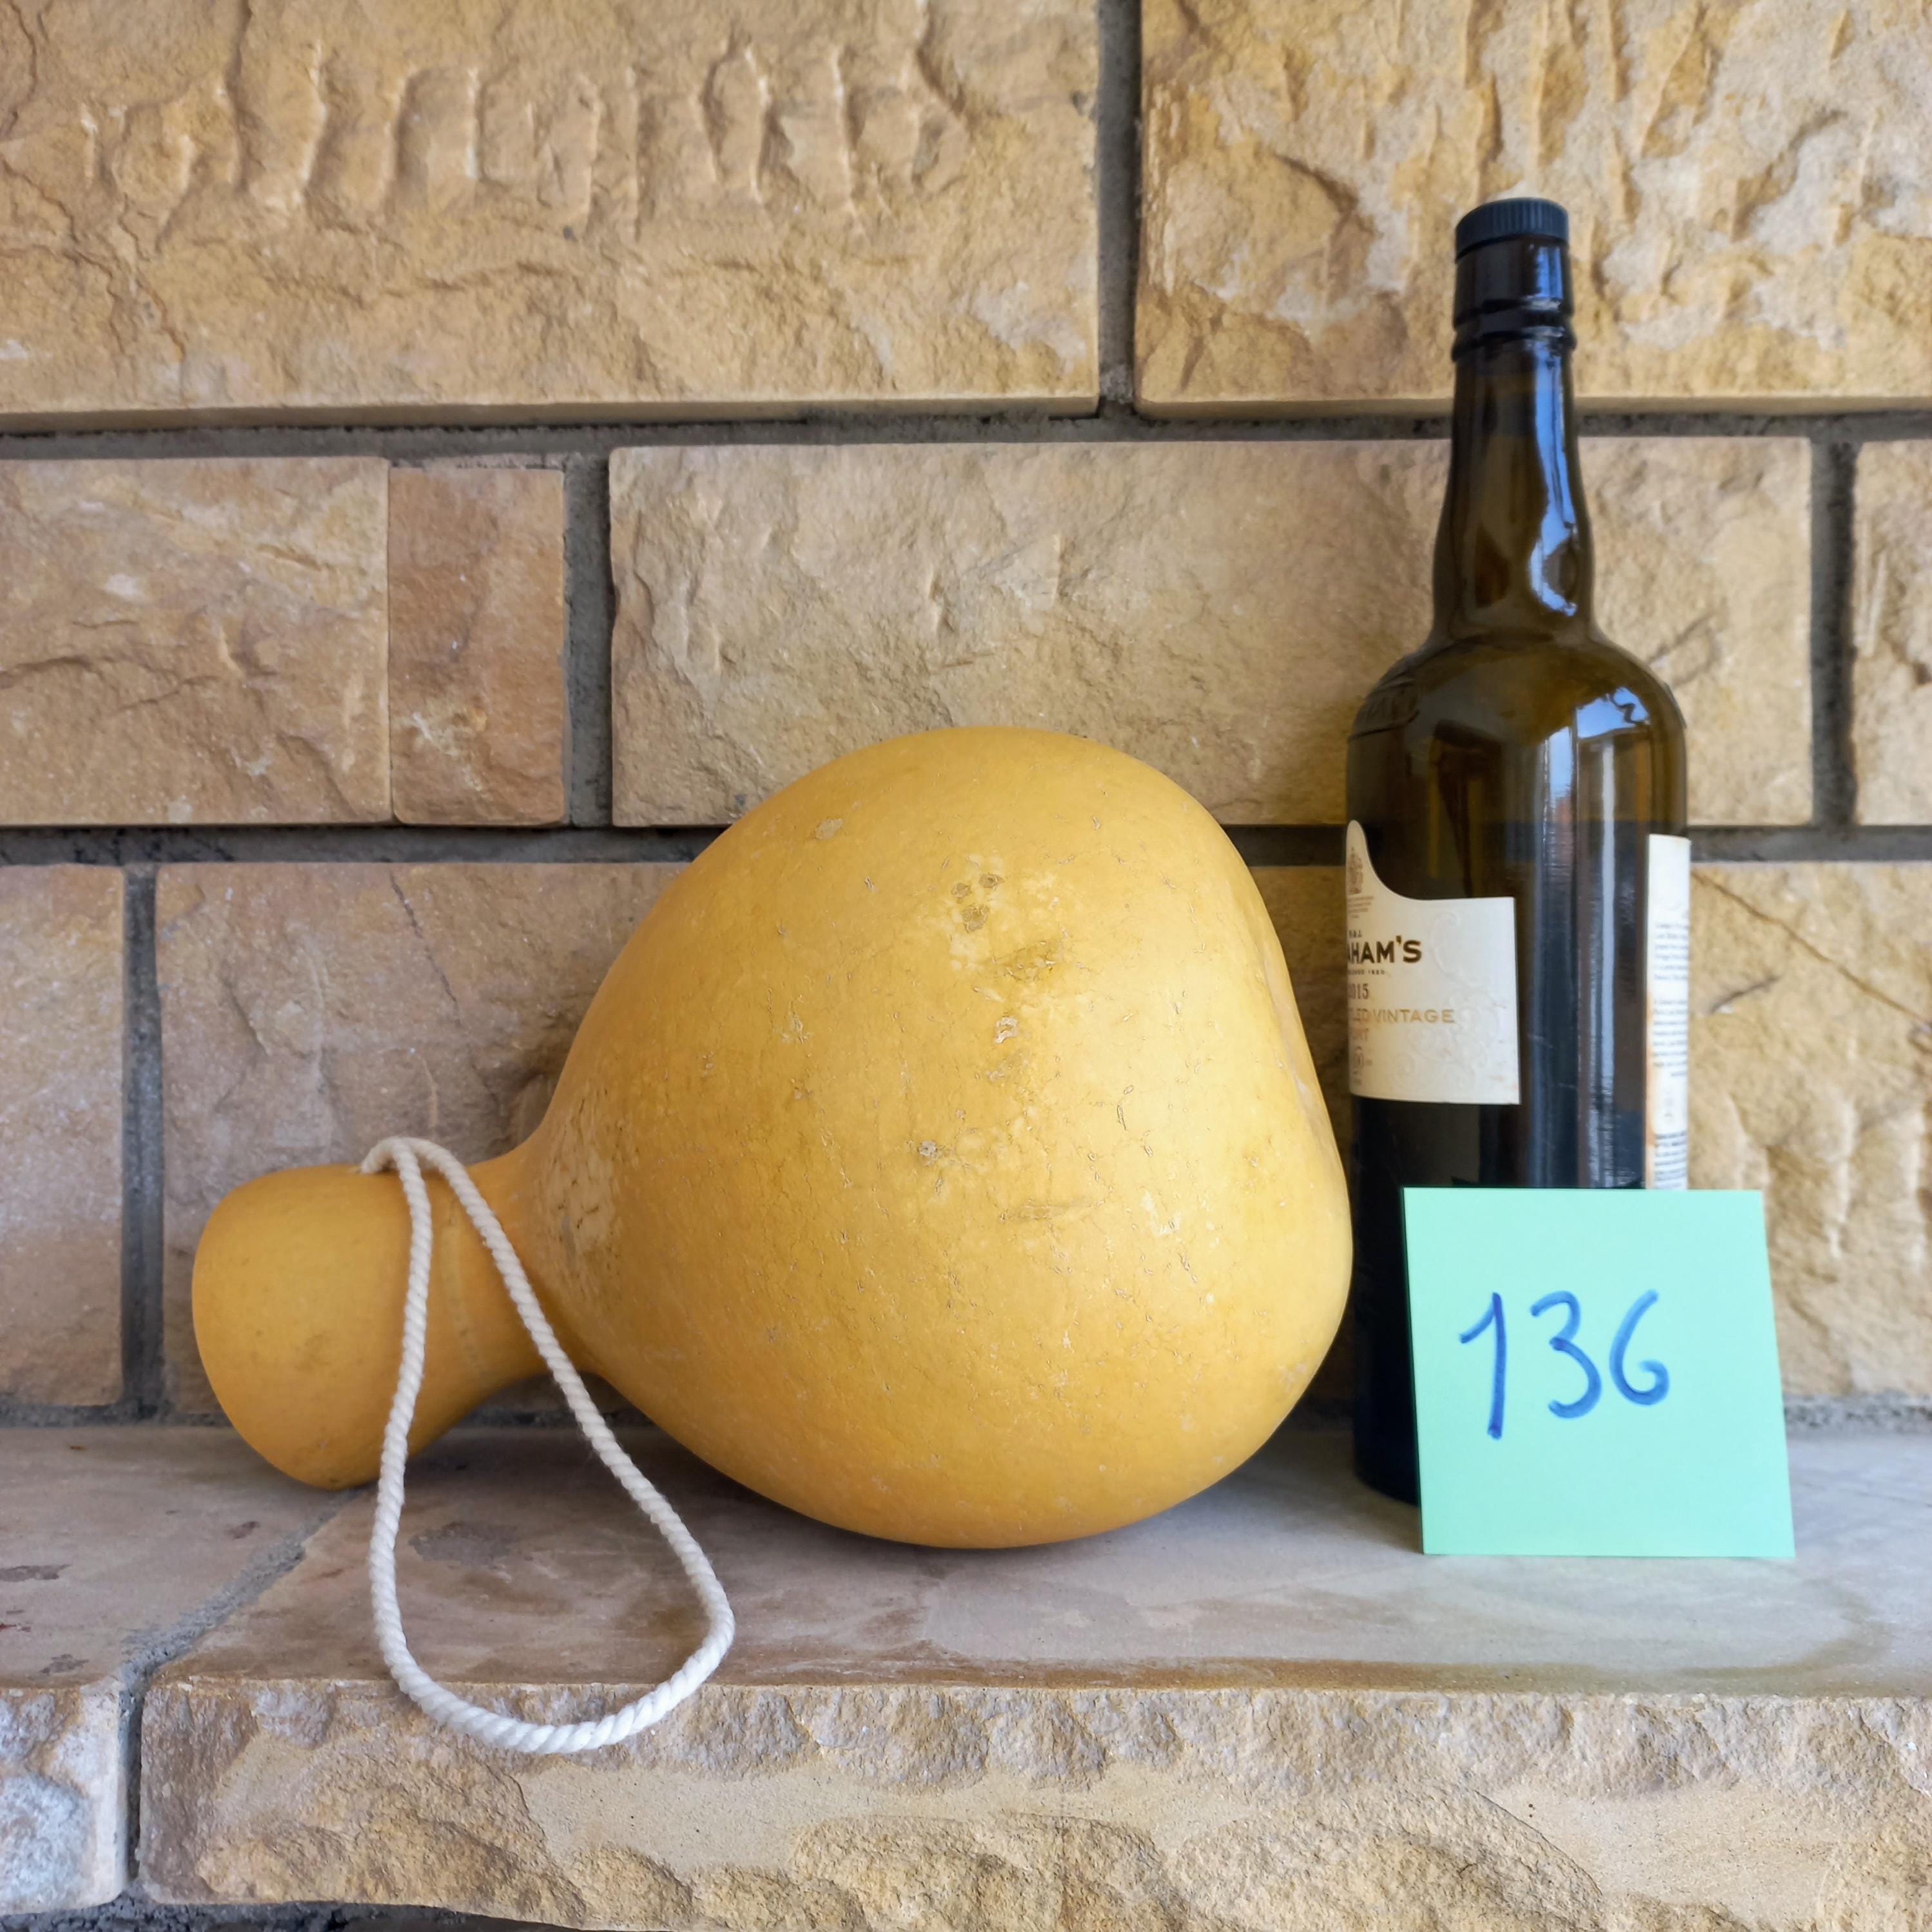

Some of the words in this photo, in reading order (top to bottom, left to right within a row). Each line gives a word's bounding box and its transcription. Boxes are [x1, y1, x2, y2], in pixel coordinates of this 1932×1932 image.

[1349, 983, 1368, 999] 015
[1373, 1009, 1454, 1023] VINTAGE
[1459, 1289, 1669, 1439] 136
